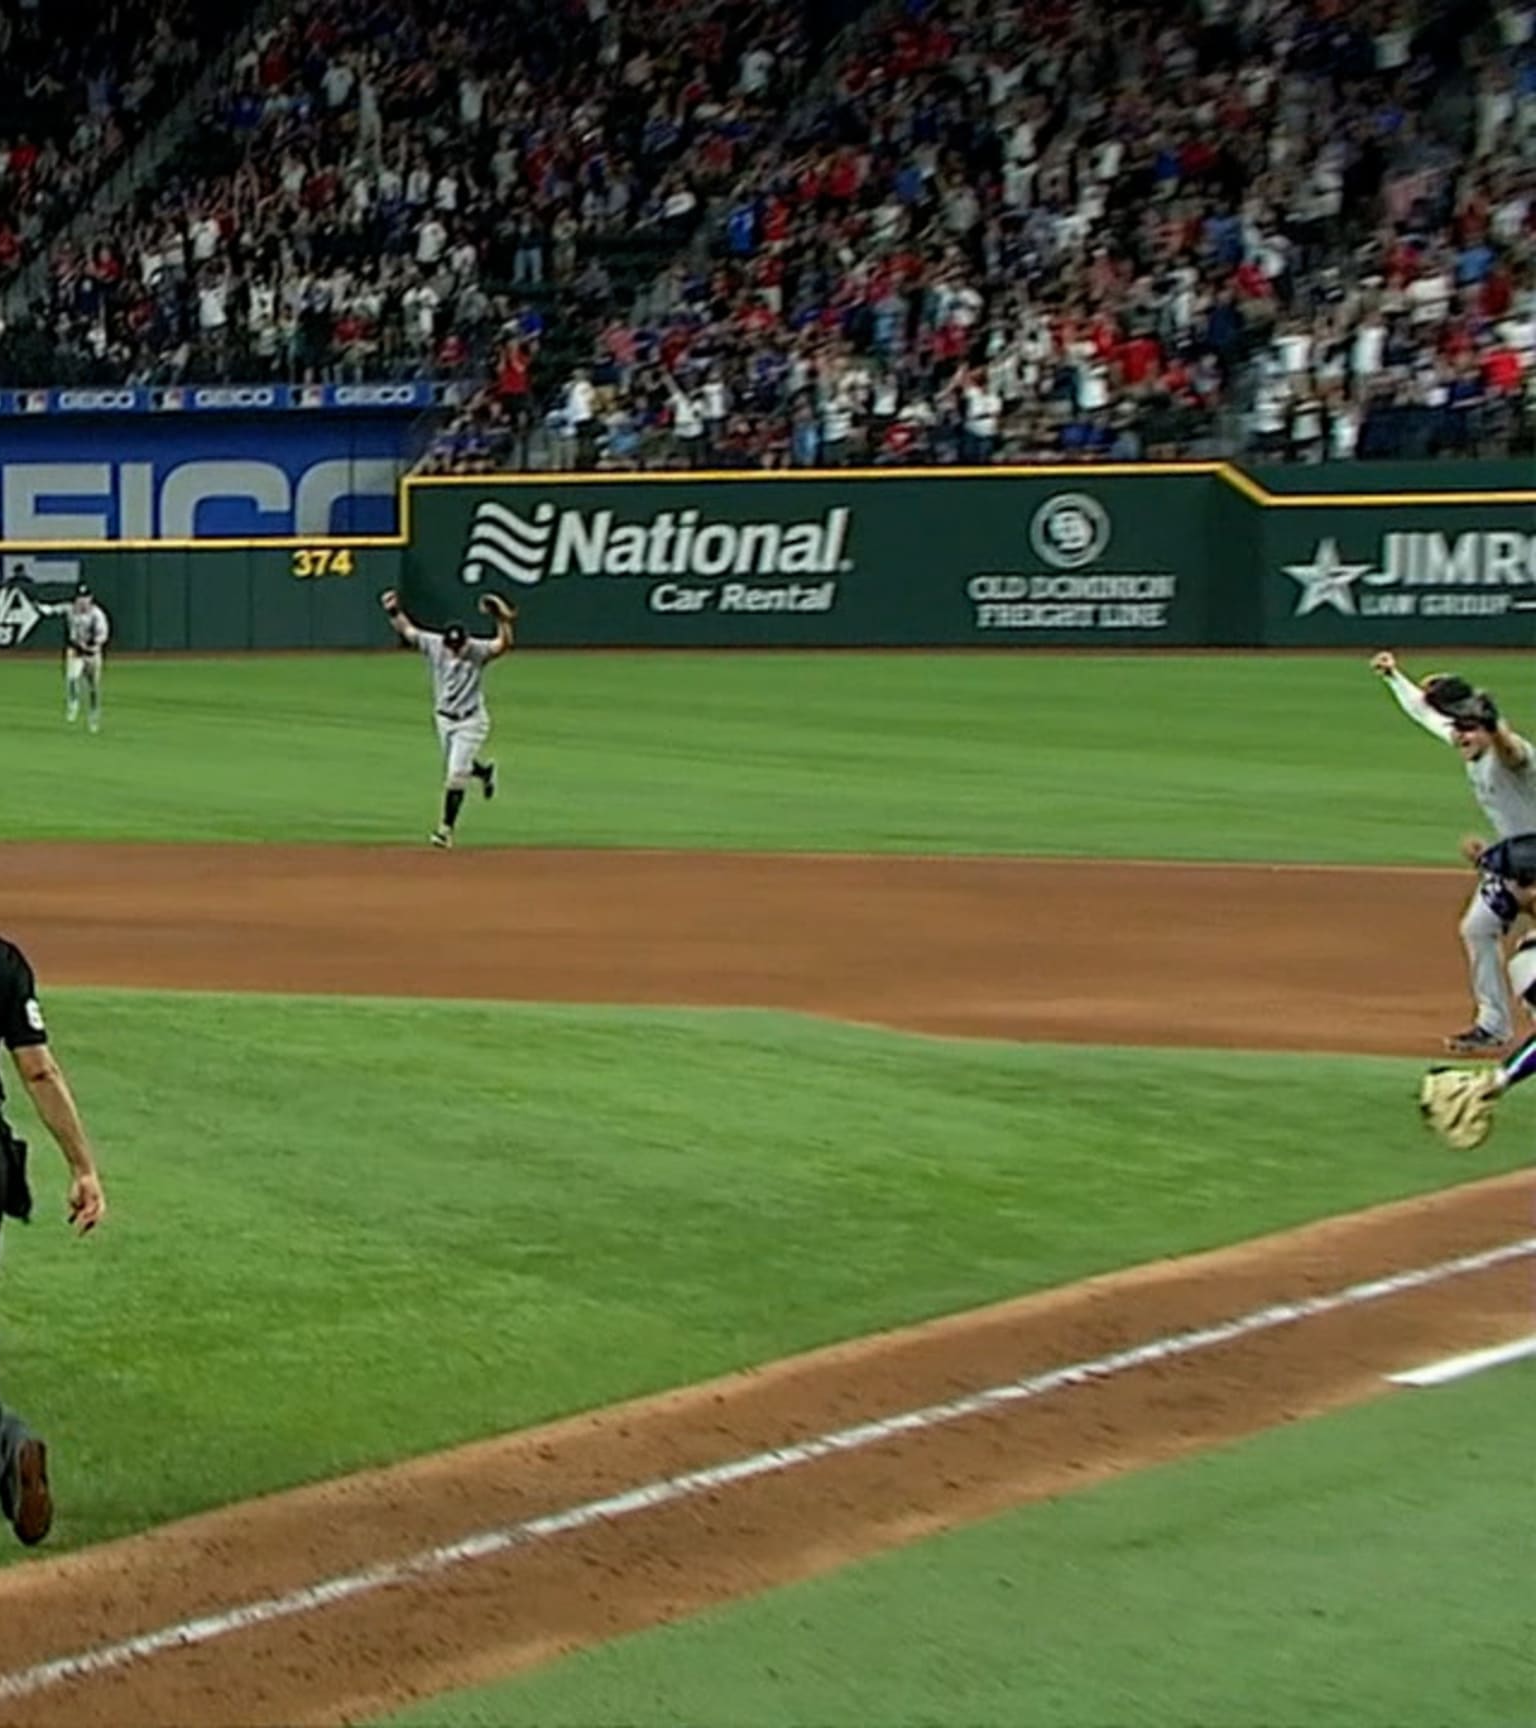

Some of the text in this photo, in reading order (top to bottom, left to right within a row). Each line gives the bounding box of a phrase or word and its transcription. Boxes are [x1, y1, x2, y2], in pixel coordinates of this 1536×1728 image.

[57, 390, 136, 409] GEICO
[193, 388, 273, 407] GEICO
[334, 386, 415, 405] GEICO
[550, 508, 849, 575] National
[293, 551, 353, 578] 374
[1362, 530, 1536, 587] JIMR
[651, 582, 835, 612] Car Rental
